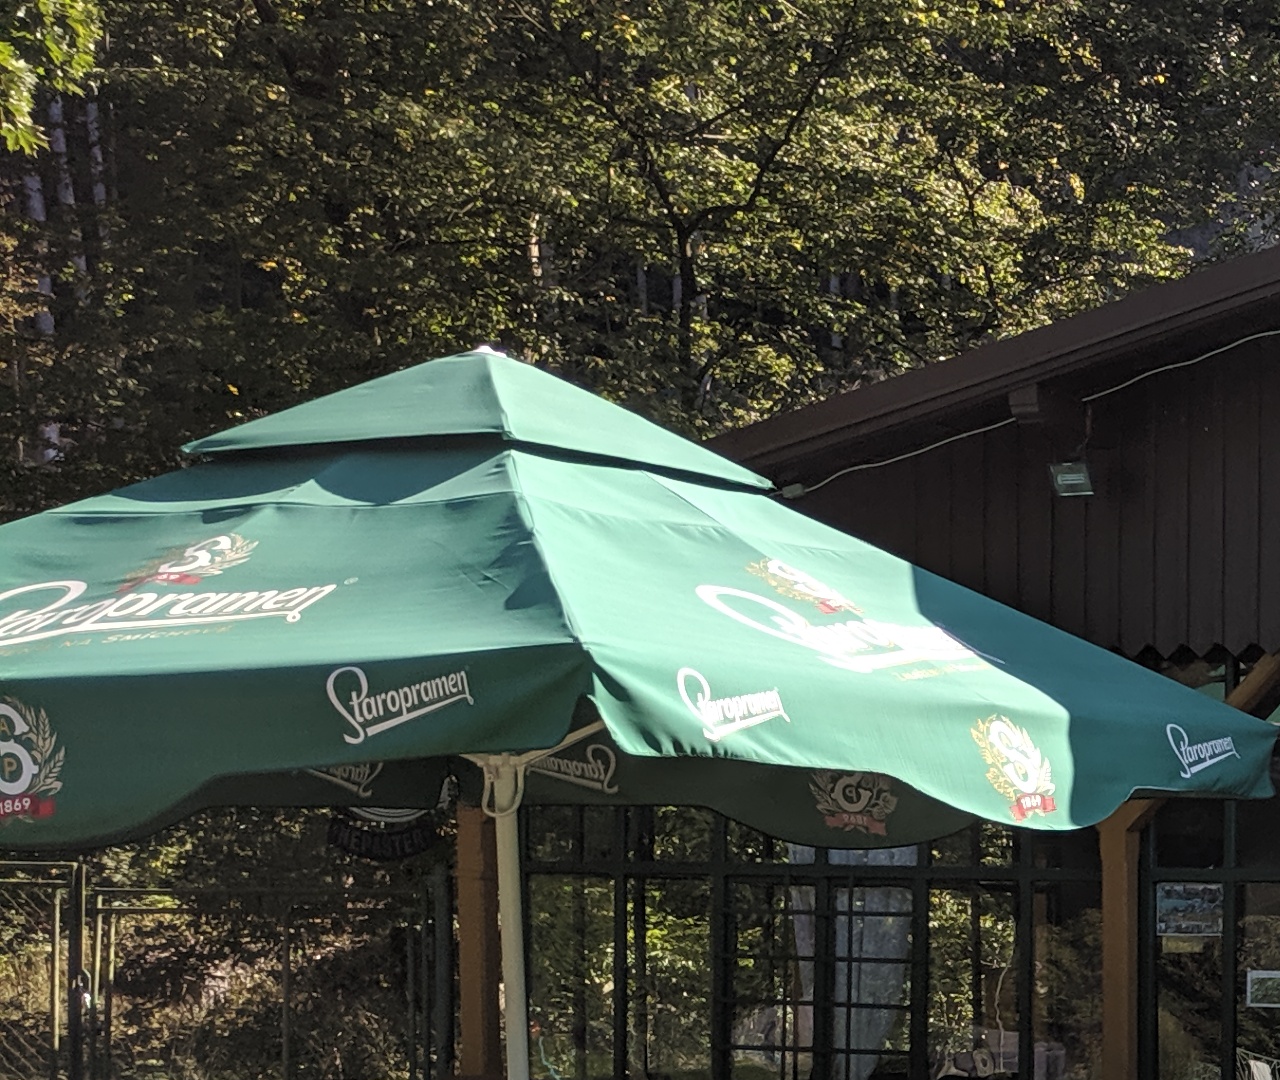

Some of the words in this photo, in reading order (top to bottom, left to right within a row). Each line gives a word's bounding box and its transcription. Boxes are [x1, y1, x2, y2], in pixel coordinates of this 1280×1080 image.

[326, 666, 474, 744] Staropramen
[676, 667, 790, 742] Staropramen
[1166, 723, 1241, 779] Staropramen
